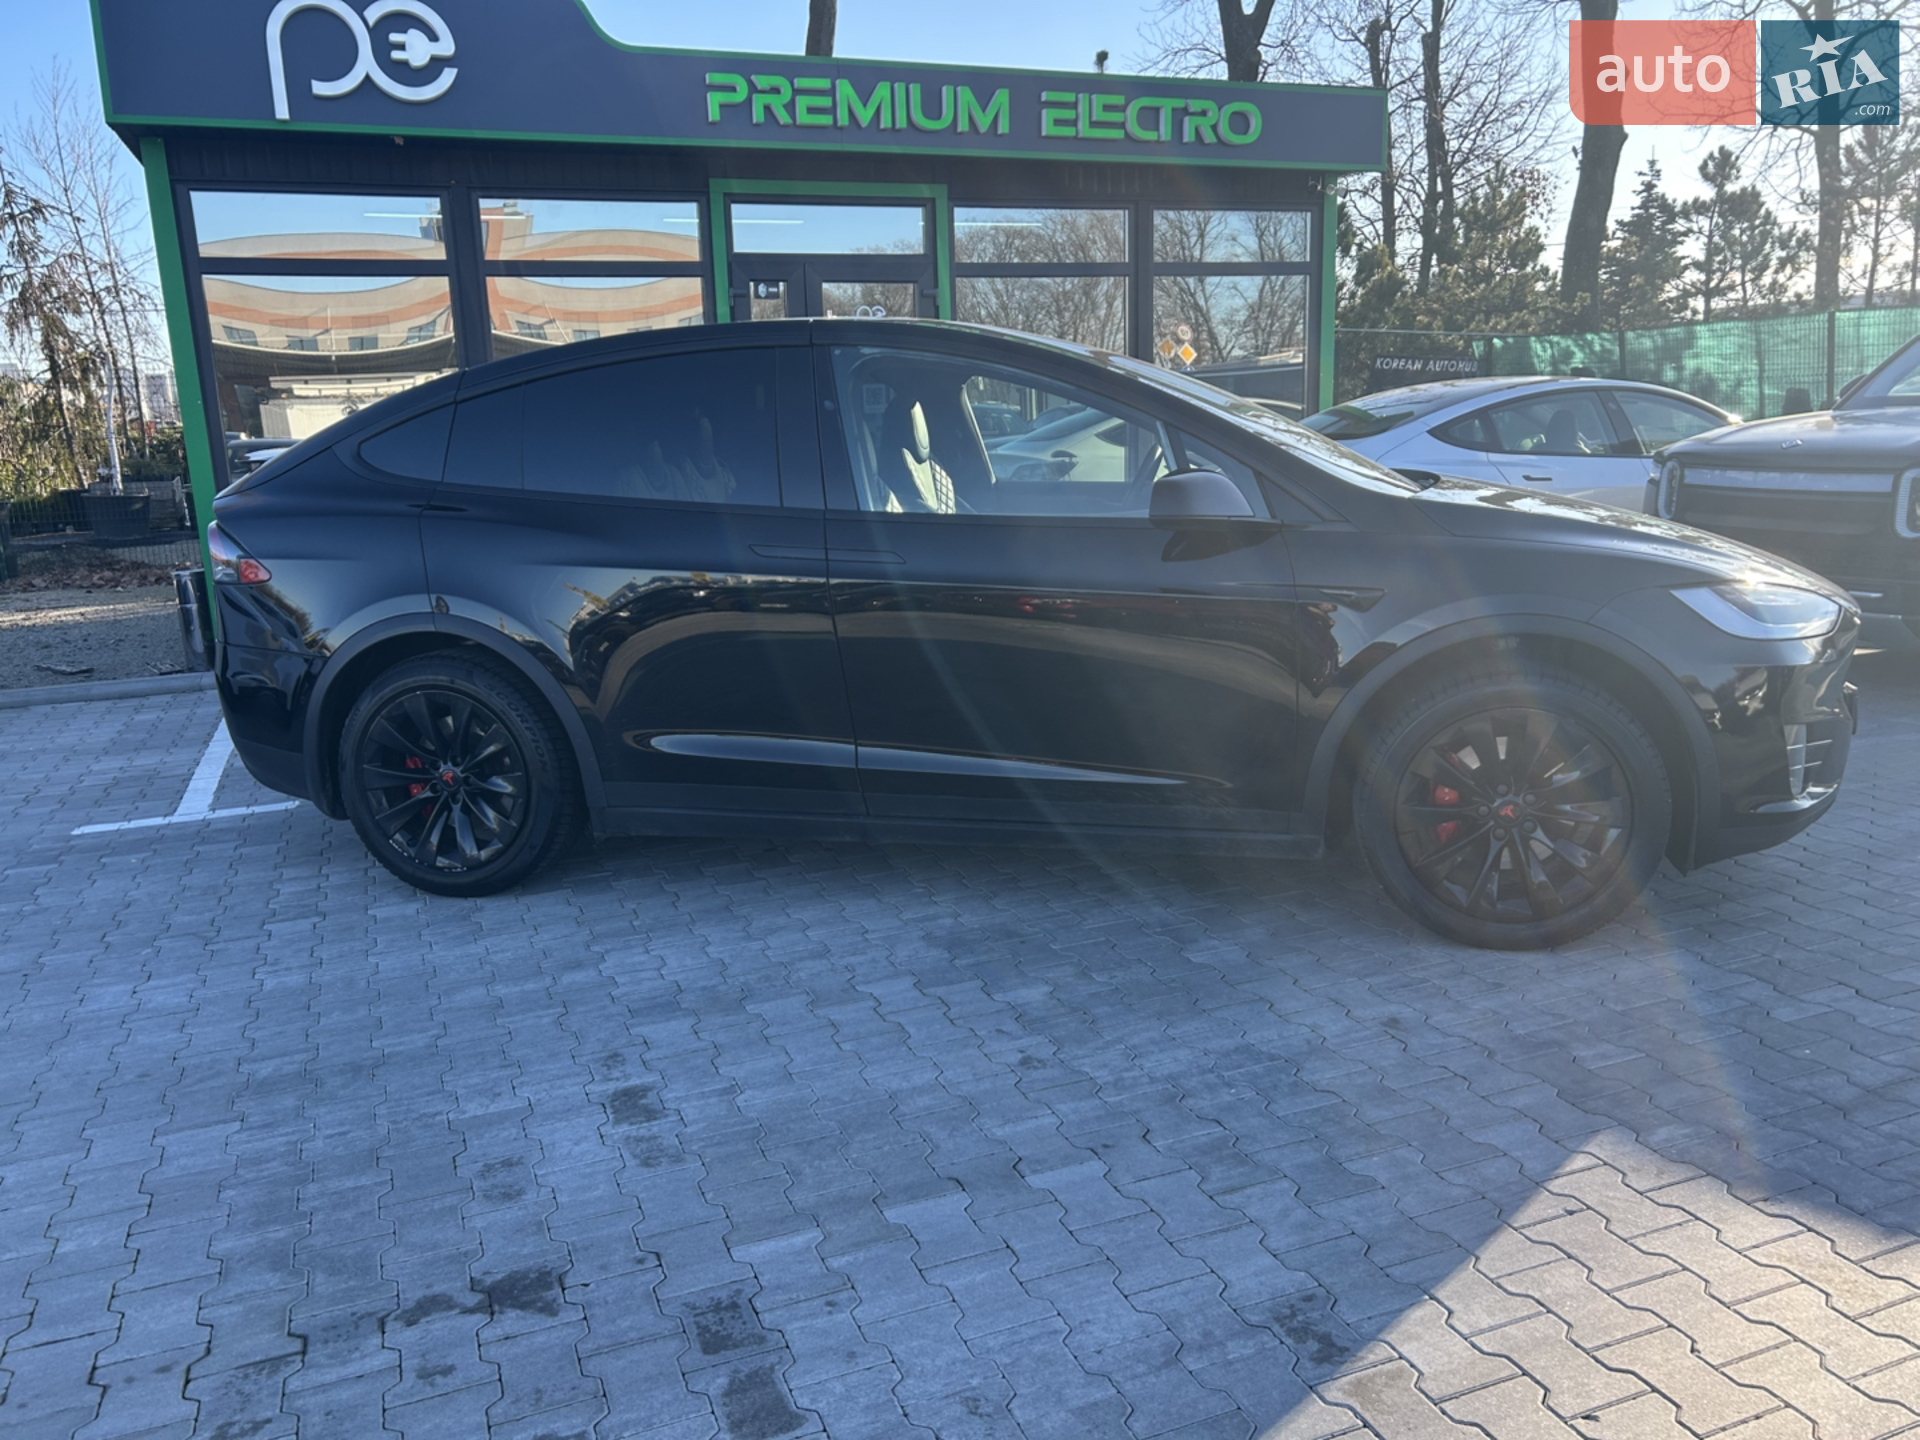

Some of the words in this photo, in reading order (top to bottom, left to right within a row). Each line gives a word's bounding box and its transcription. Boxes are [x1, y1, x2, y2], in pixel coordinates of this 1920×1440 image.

[705, 72, 1010, 135] PREMIUM
[1041, 89, 1263, 146] ELECTRO
[1375, 357, 1423, 371] KOREAN
[1426, 360, 1479, 373] AUTOHUB
[483, 683, 549, 773] SCORPION
